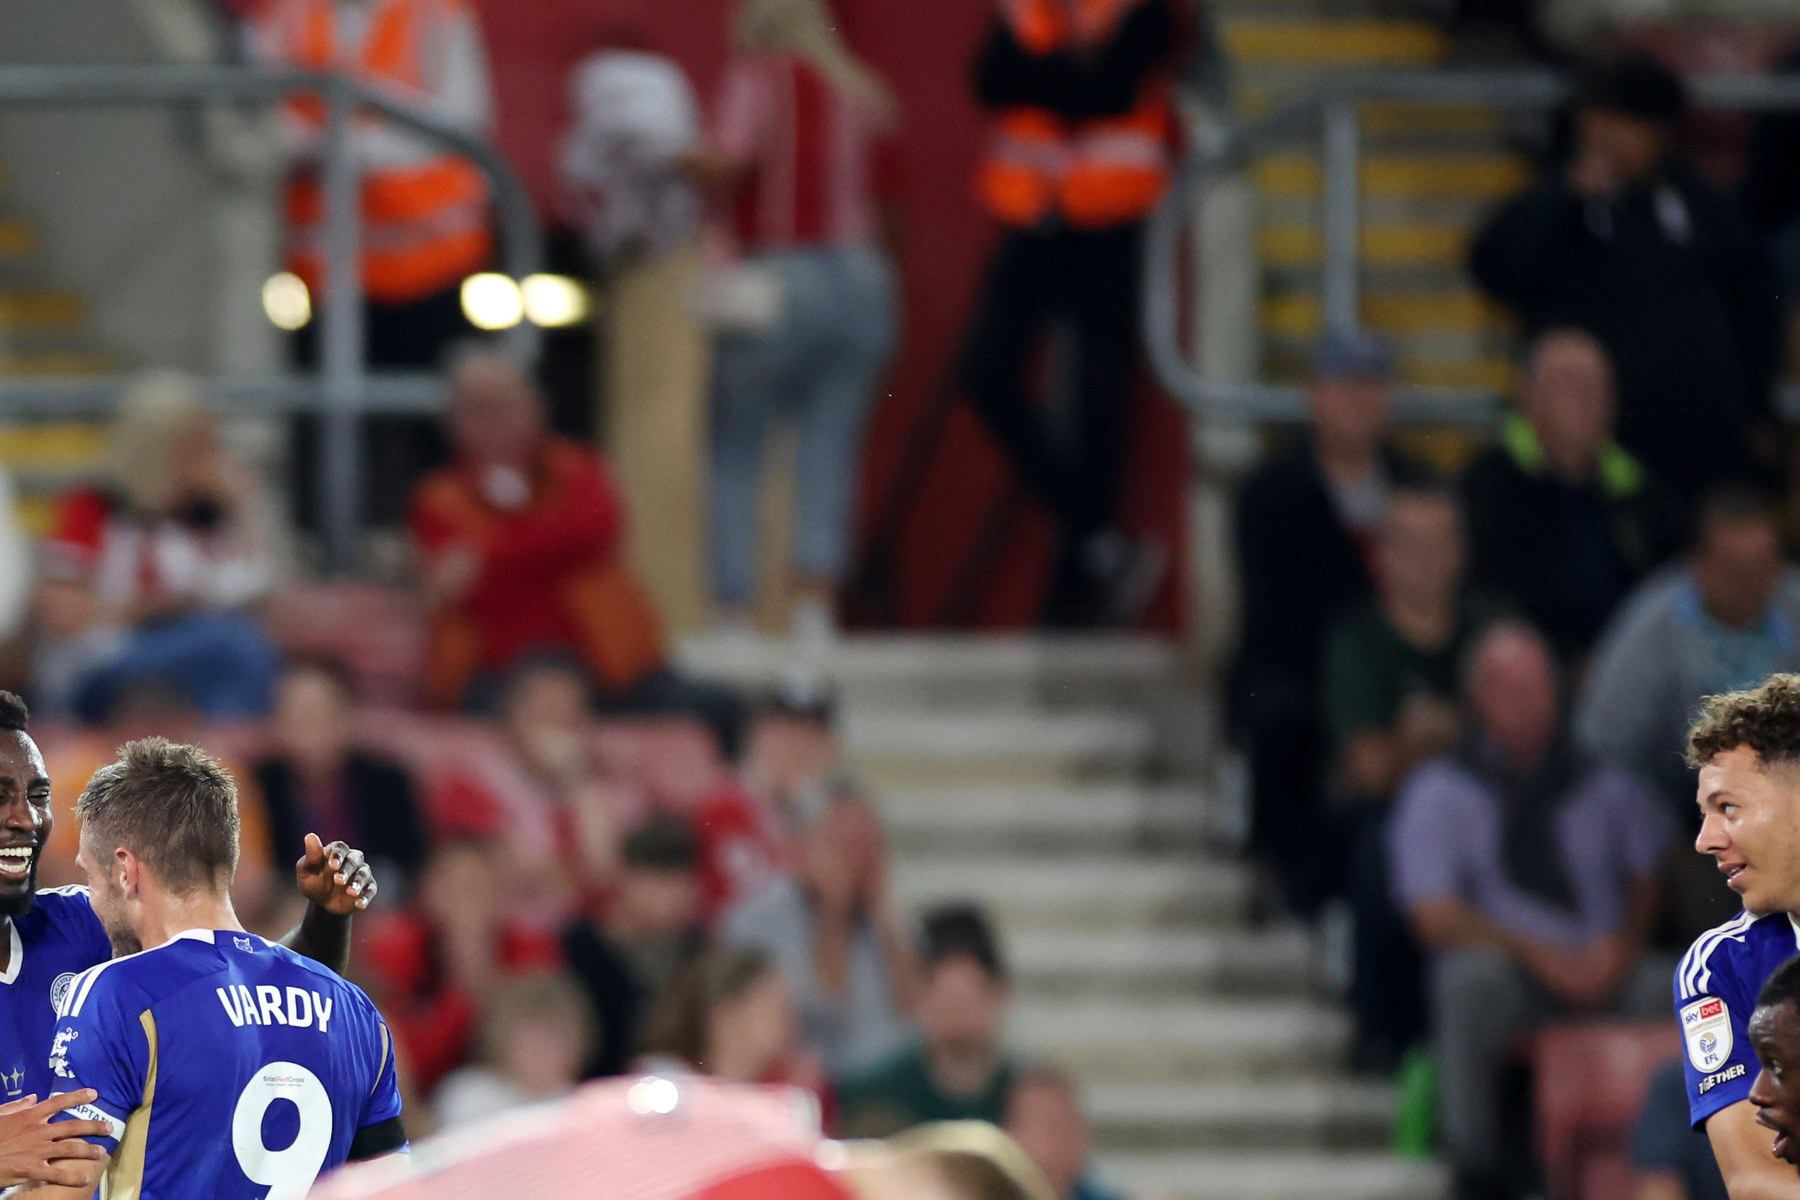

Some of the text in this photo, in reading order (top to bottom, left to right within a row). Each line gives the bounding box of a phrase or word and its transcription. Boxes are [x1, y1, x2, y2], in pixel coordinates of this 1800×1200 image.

[216, 985, 332, 1033] VARDY
[1685, 1002, 1721, 1024] sky bet
[1704, 1053, 1719, 1065] EFL
